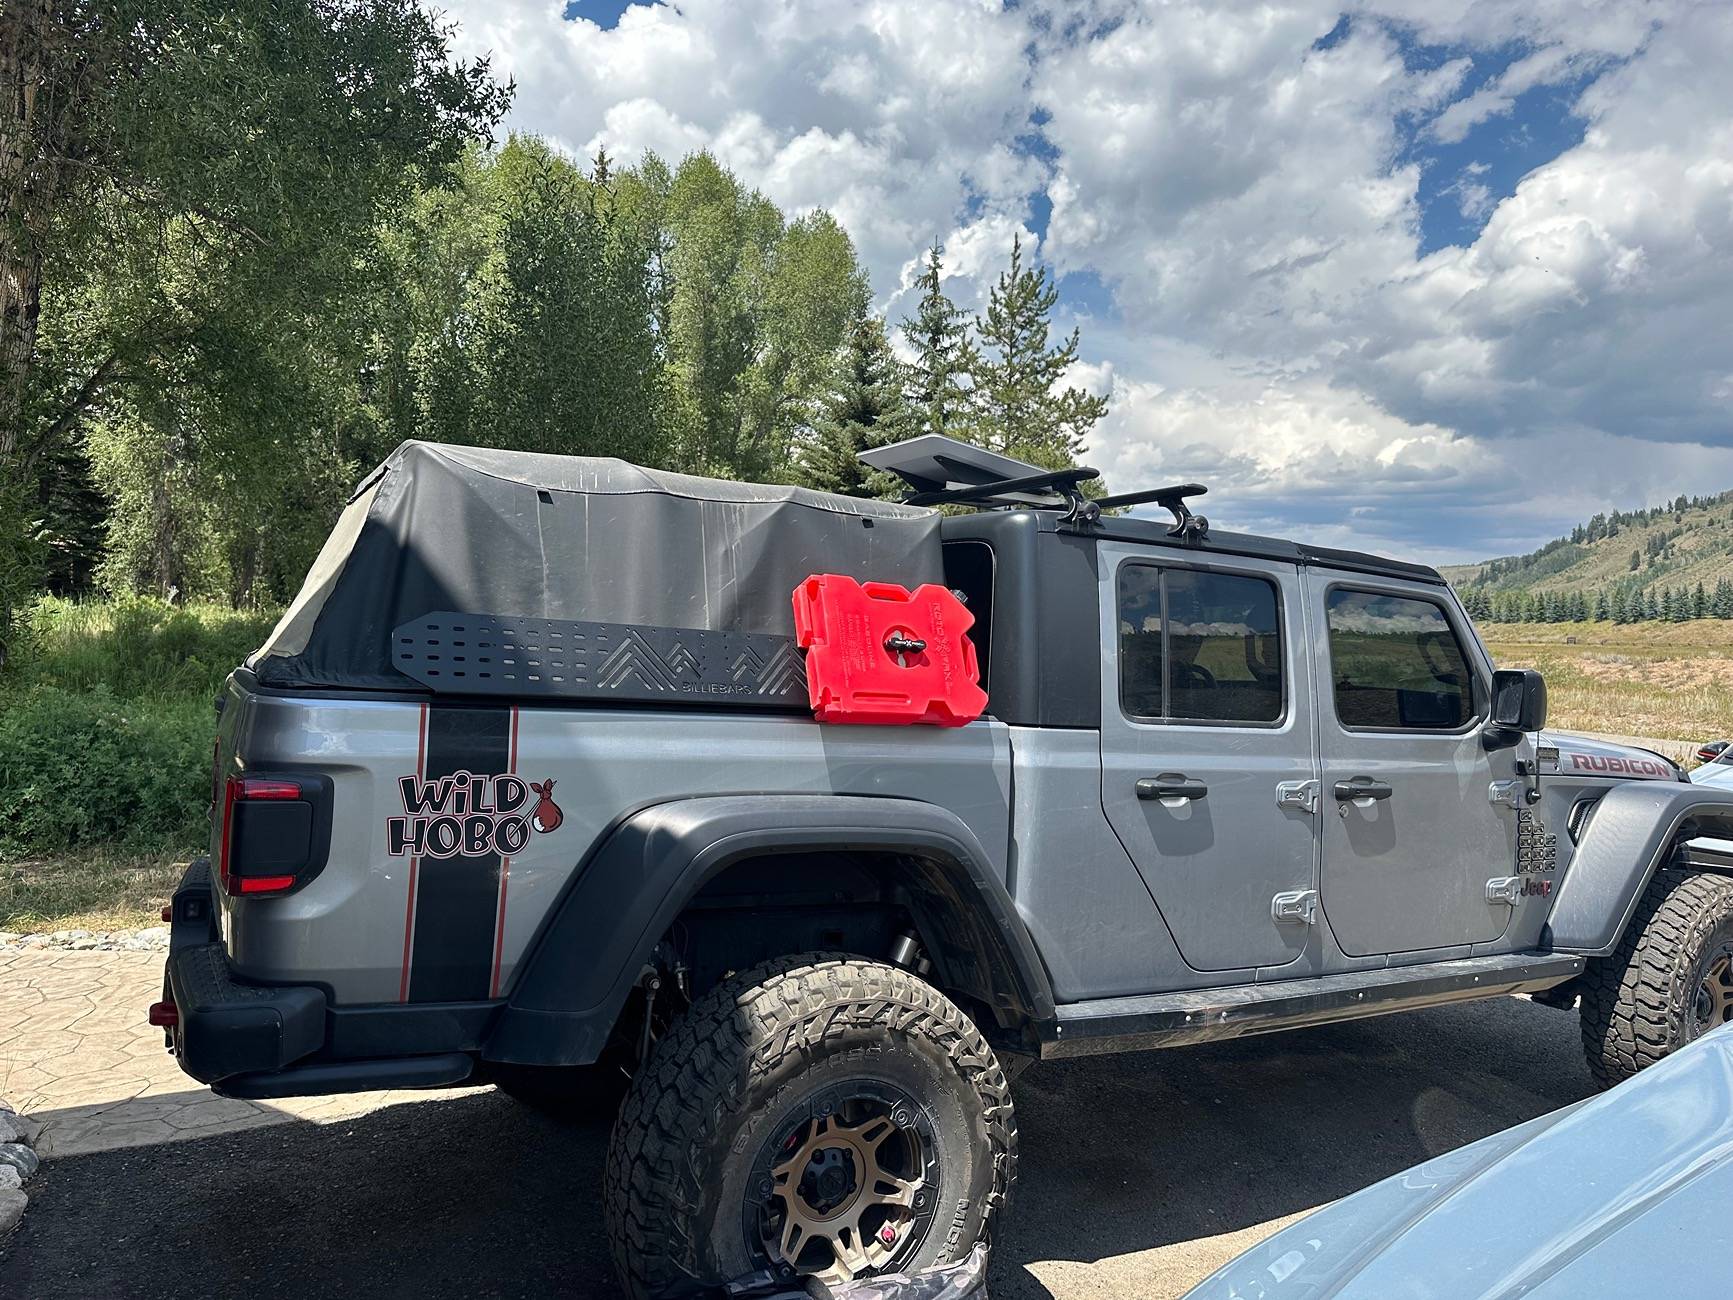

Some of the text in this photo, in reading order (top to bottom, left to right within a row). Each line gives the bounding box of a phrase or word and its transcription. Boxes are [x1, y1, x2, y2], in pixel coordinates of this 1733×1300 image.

[1570, 754, 1671, 777] RUBICON
[388, 815, 530, 857] HOBO
[1520, 877, 1552, 898] Jeep
